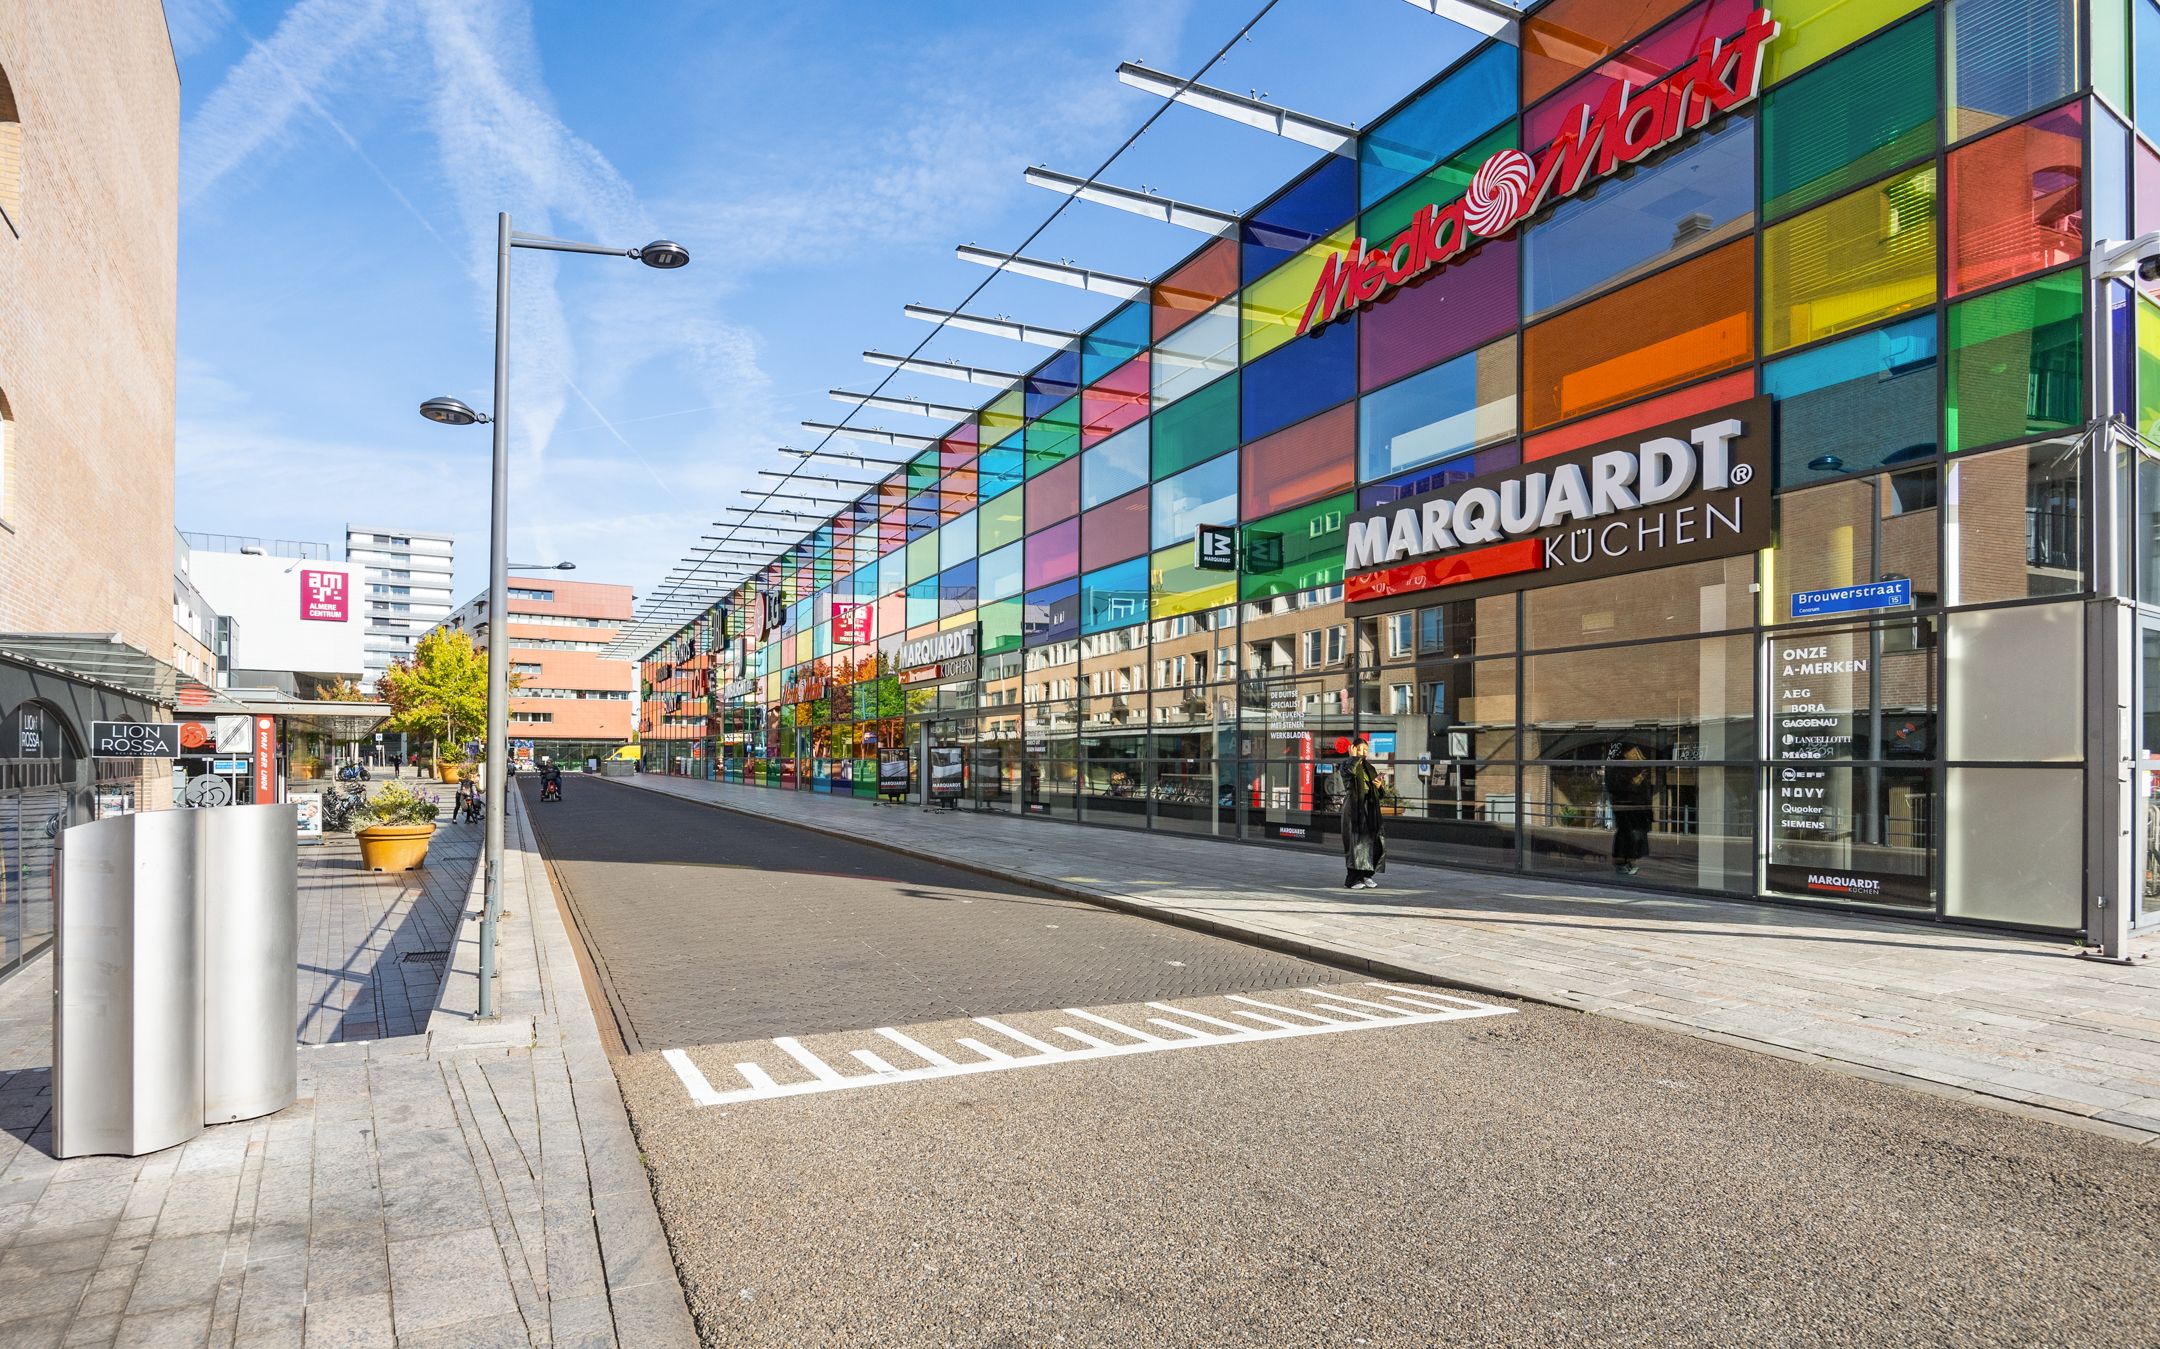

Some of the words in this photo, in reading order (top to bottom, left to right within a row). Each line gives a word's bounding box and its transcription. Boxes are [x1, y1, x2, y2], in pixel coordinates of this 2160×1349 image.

[1295, 198, 1470, 336] Media
[1513, 8, 1780, 222] Markt
[1544, 496, 1744, 569] KÜCHEN
[1798, 583, 1902, 604] Brouwerstraat
[309, 603, 337, 611] ALMERE
[309, 610, 342, 618] CENTRUM
[1783, 646, 1828, 661] ONZE
[1783, 660, 1867, 676] A-MERKEN
[1270, 691, 1278, 699] DE
[1783, 689, 1811, 699] AEG
[1791, 704, 1825, 713] BORA
[1782, 718, 1838, 728] GAGGENAU
[112, 725, 160, 739] LION
[101, 738, 170, 752] ROSSA
[1795, 736, 1852, 744] LANCELLOTTI
[1782, 751, 1821, 759] Miele
[1781, 788, 1824, 798] NOVY
[1781, 820, 1825, 830] SIEMENS
